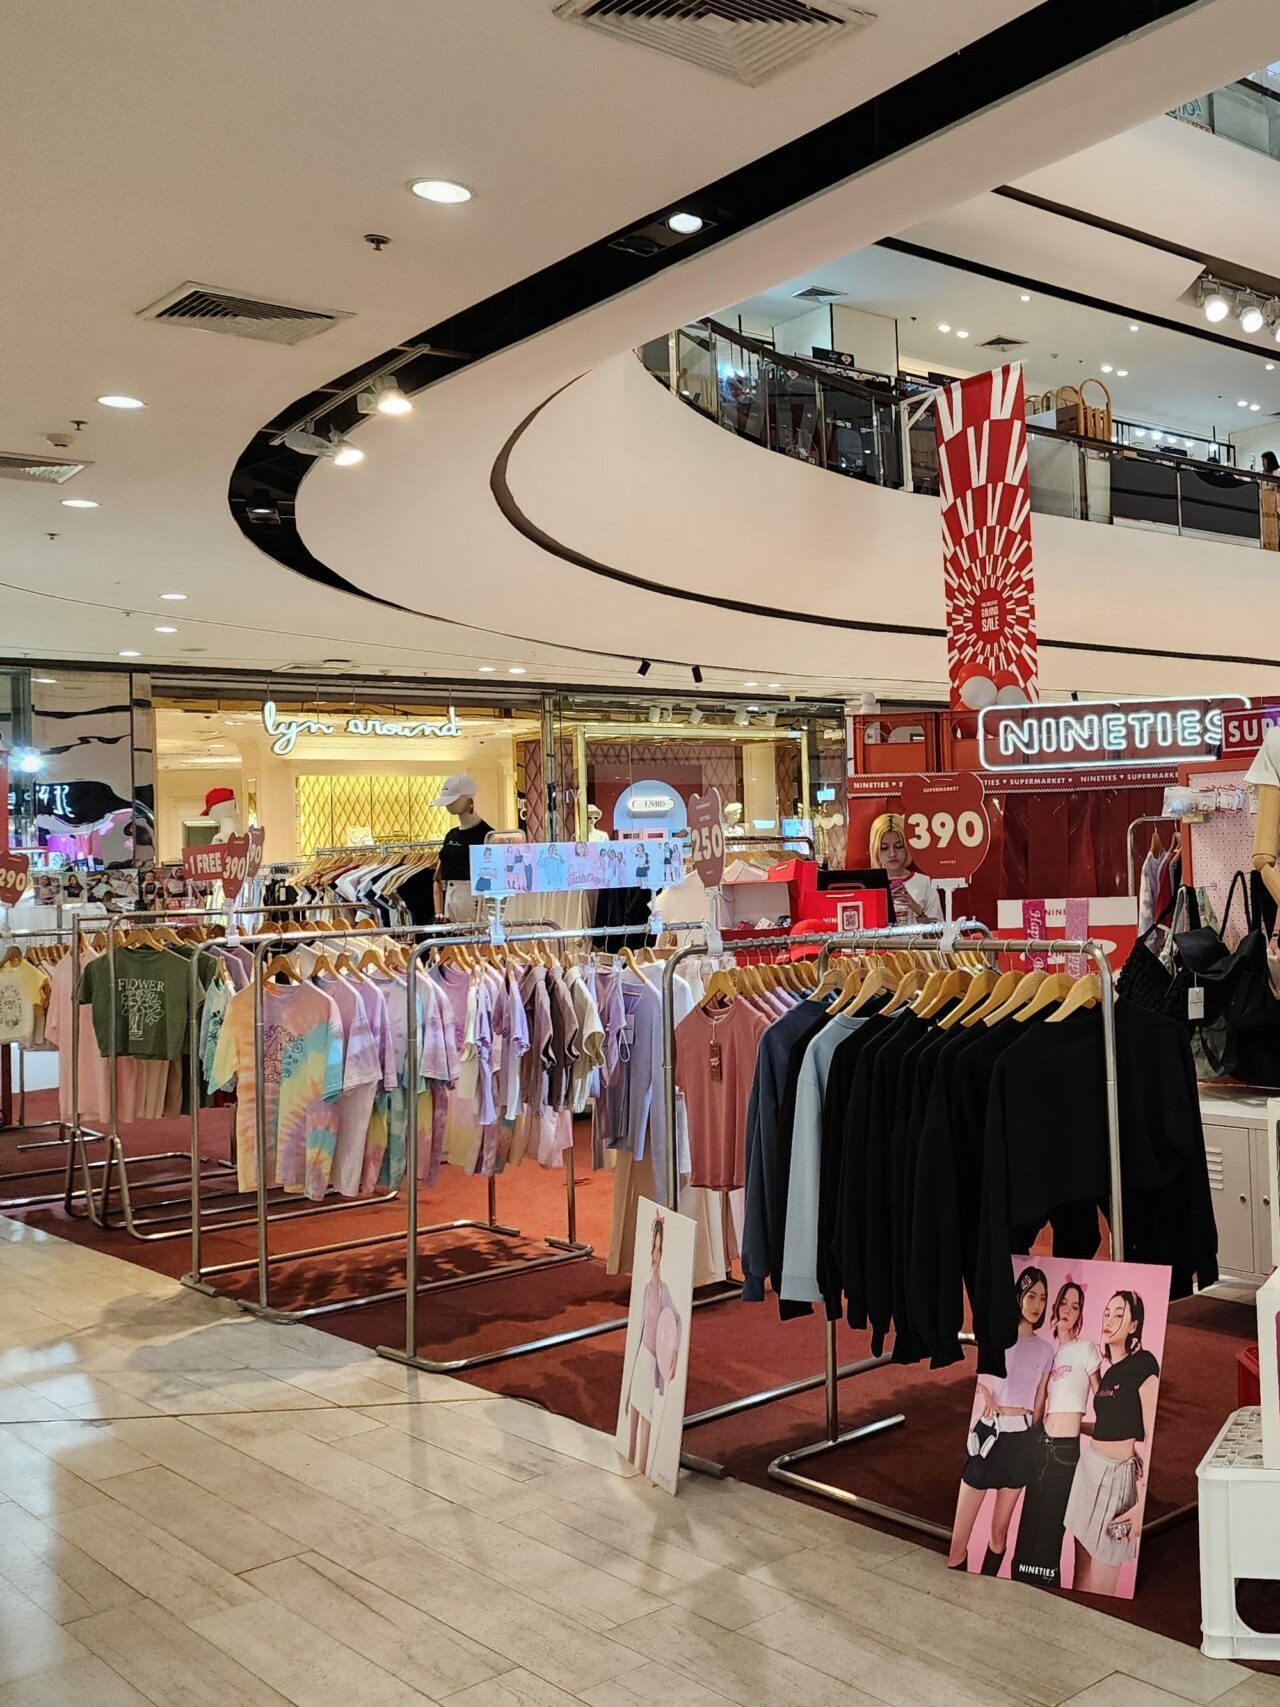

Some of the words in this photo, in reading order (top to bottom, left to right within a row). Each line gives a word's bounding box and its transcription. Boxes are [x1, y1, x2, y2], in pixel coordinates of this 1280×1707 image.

[981, 616, 1000, 632] SALE
[262, 700, 335, 755] lyn
[347, 705, 464, 738] around
[999, 708, 1222, 756] NINETIES
[853, 781, 890, 789] NINETIES
[1009, 777, 1066, 786] SUPERMARKET
[1080, 774, 1117, 783] NINETIES
[1127, 771, 1178, 780] SUPERMARKE
[907, 810, 984, 850] 390
[249, 843, 262, 865] 90
[692, 824, 723, 861] 250
[196, 852, 222, 874] FREE
[222, 856, 246, 880] 390
[0, 868, 26, 892] 290
[1019, 1563, 1055, 1578] NINETIES
